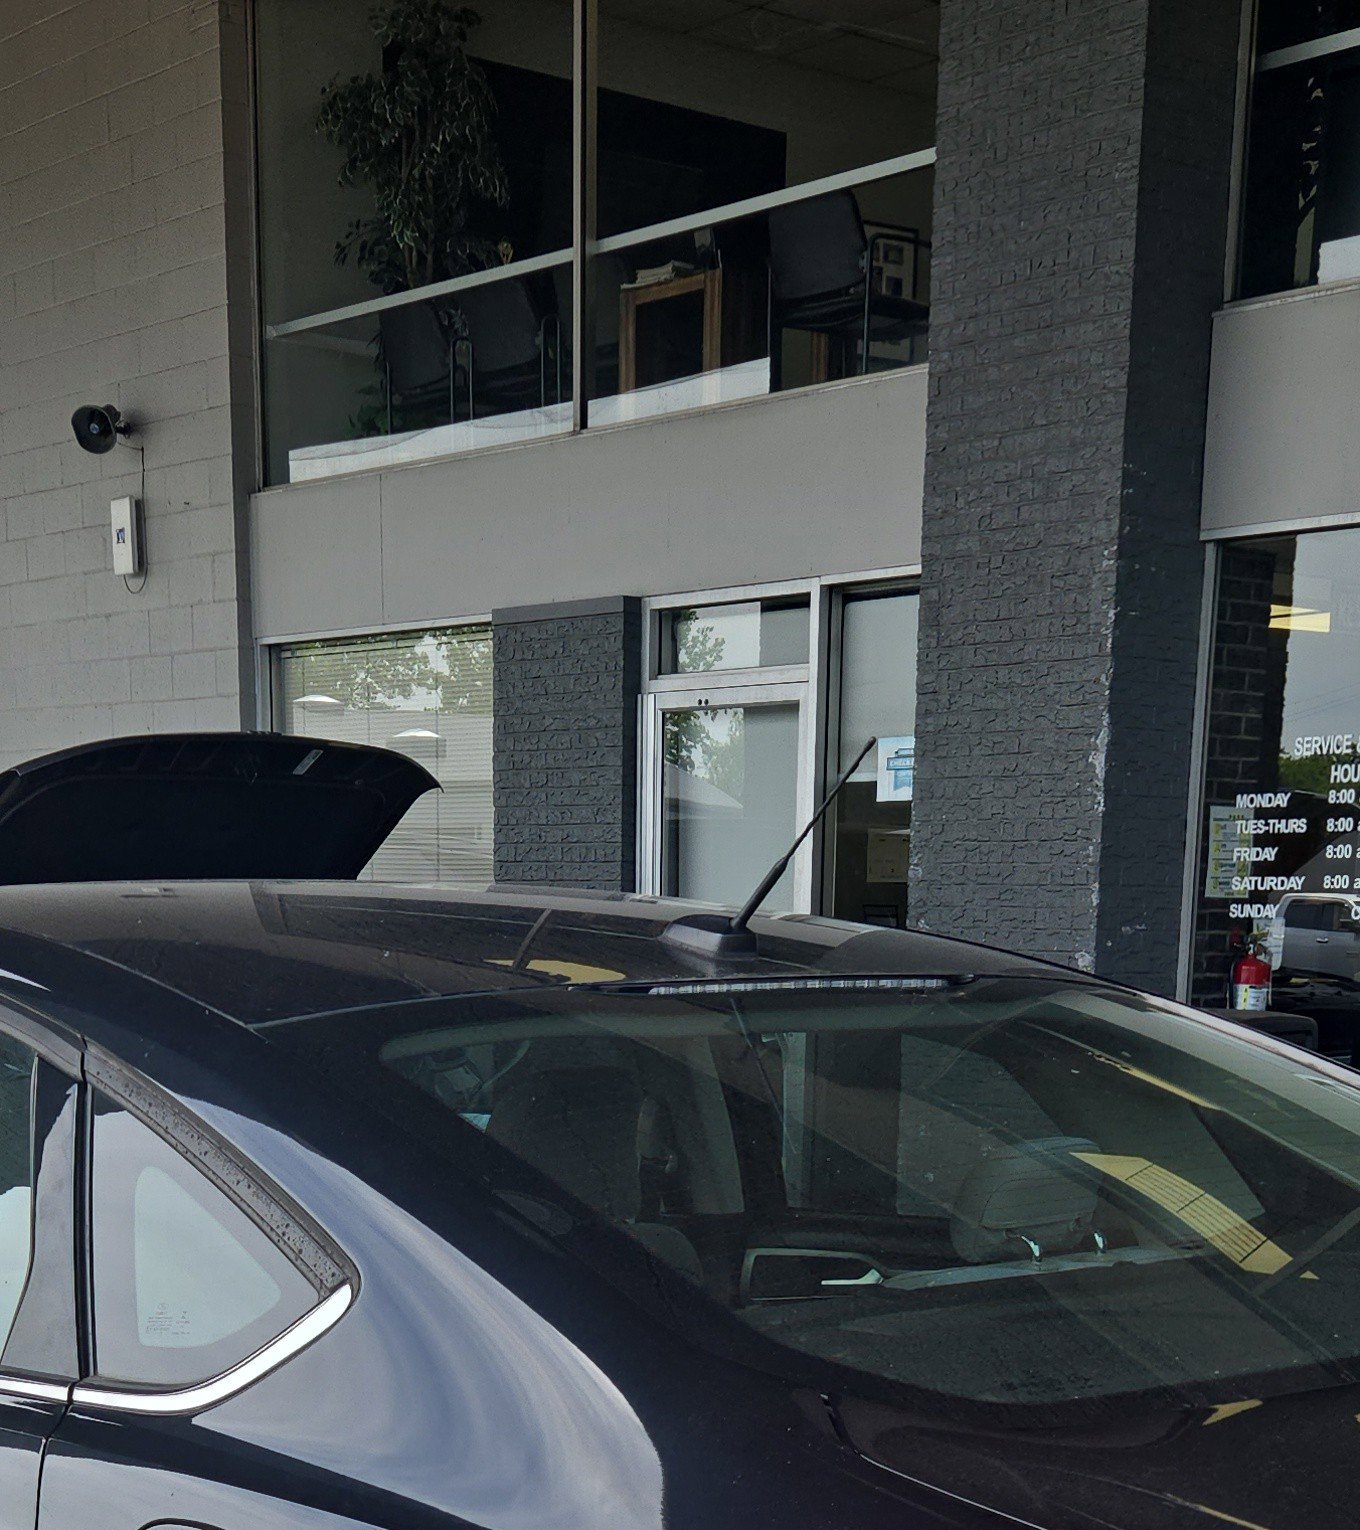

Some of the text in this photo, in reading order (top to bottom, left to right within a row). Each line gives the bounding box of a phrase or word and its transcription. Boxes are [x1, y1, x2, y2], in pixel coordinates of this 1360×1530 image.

[1294, 734, 1353, 757] SERVICE
[1236, 792, 1291, 809] MONDAY
[1328, 789, 1356, 804] 8:00
[1235, 818, 1307, 834] TUES-THURS
[1326, 818, 1353, 832] 8:00
[1232, 847, 1279, 862] FRIDAY
[1325, 845, 1352, 859] 8:00
[1231, 876, 1306, 891] SATURDAY
[1323, 875, 1349, 889] 8:00
[1229, 903, 1280, 919] SUNDAY
